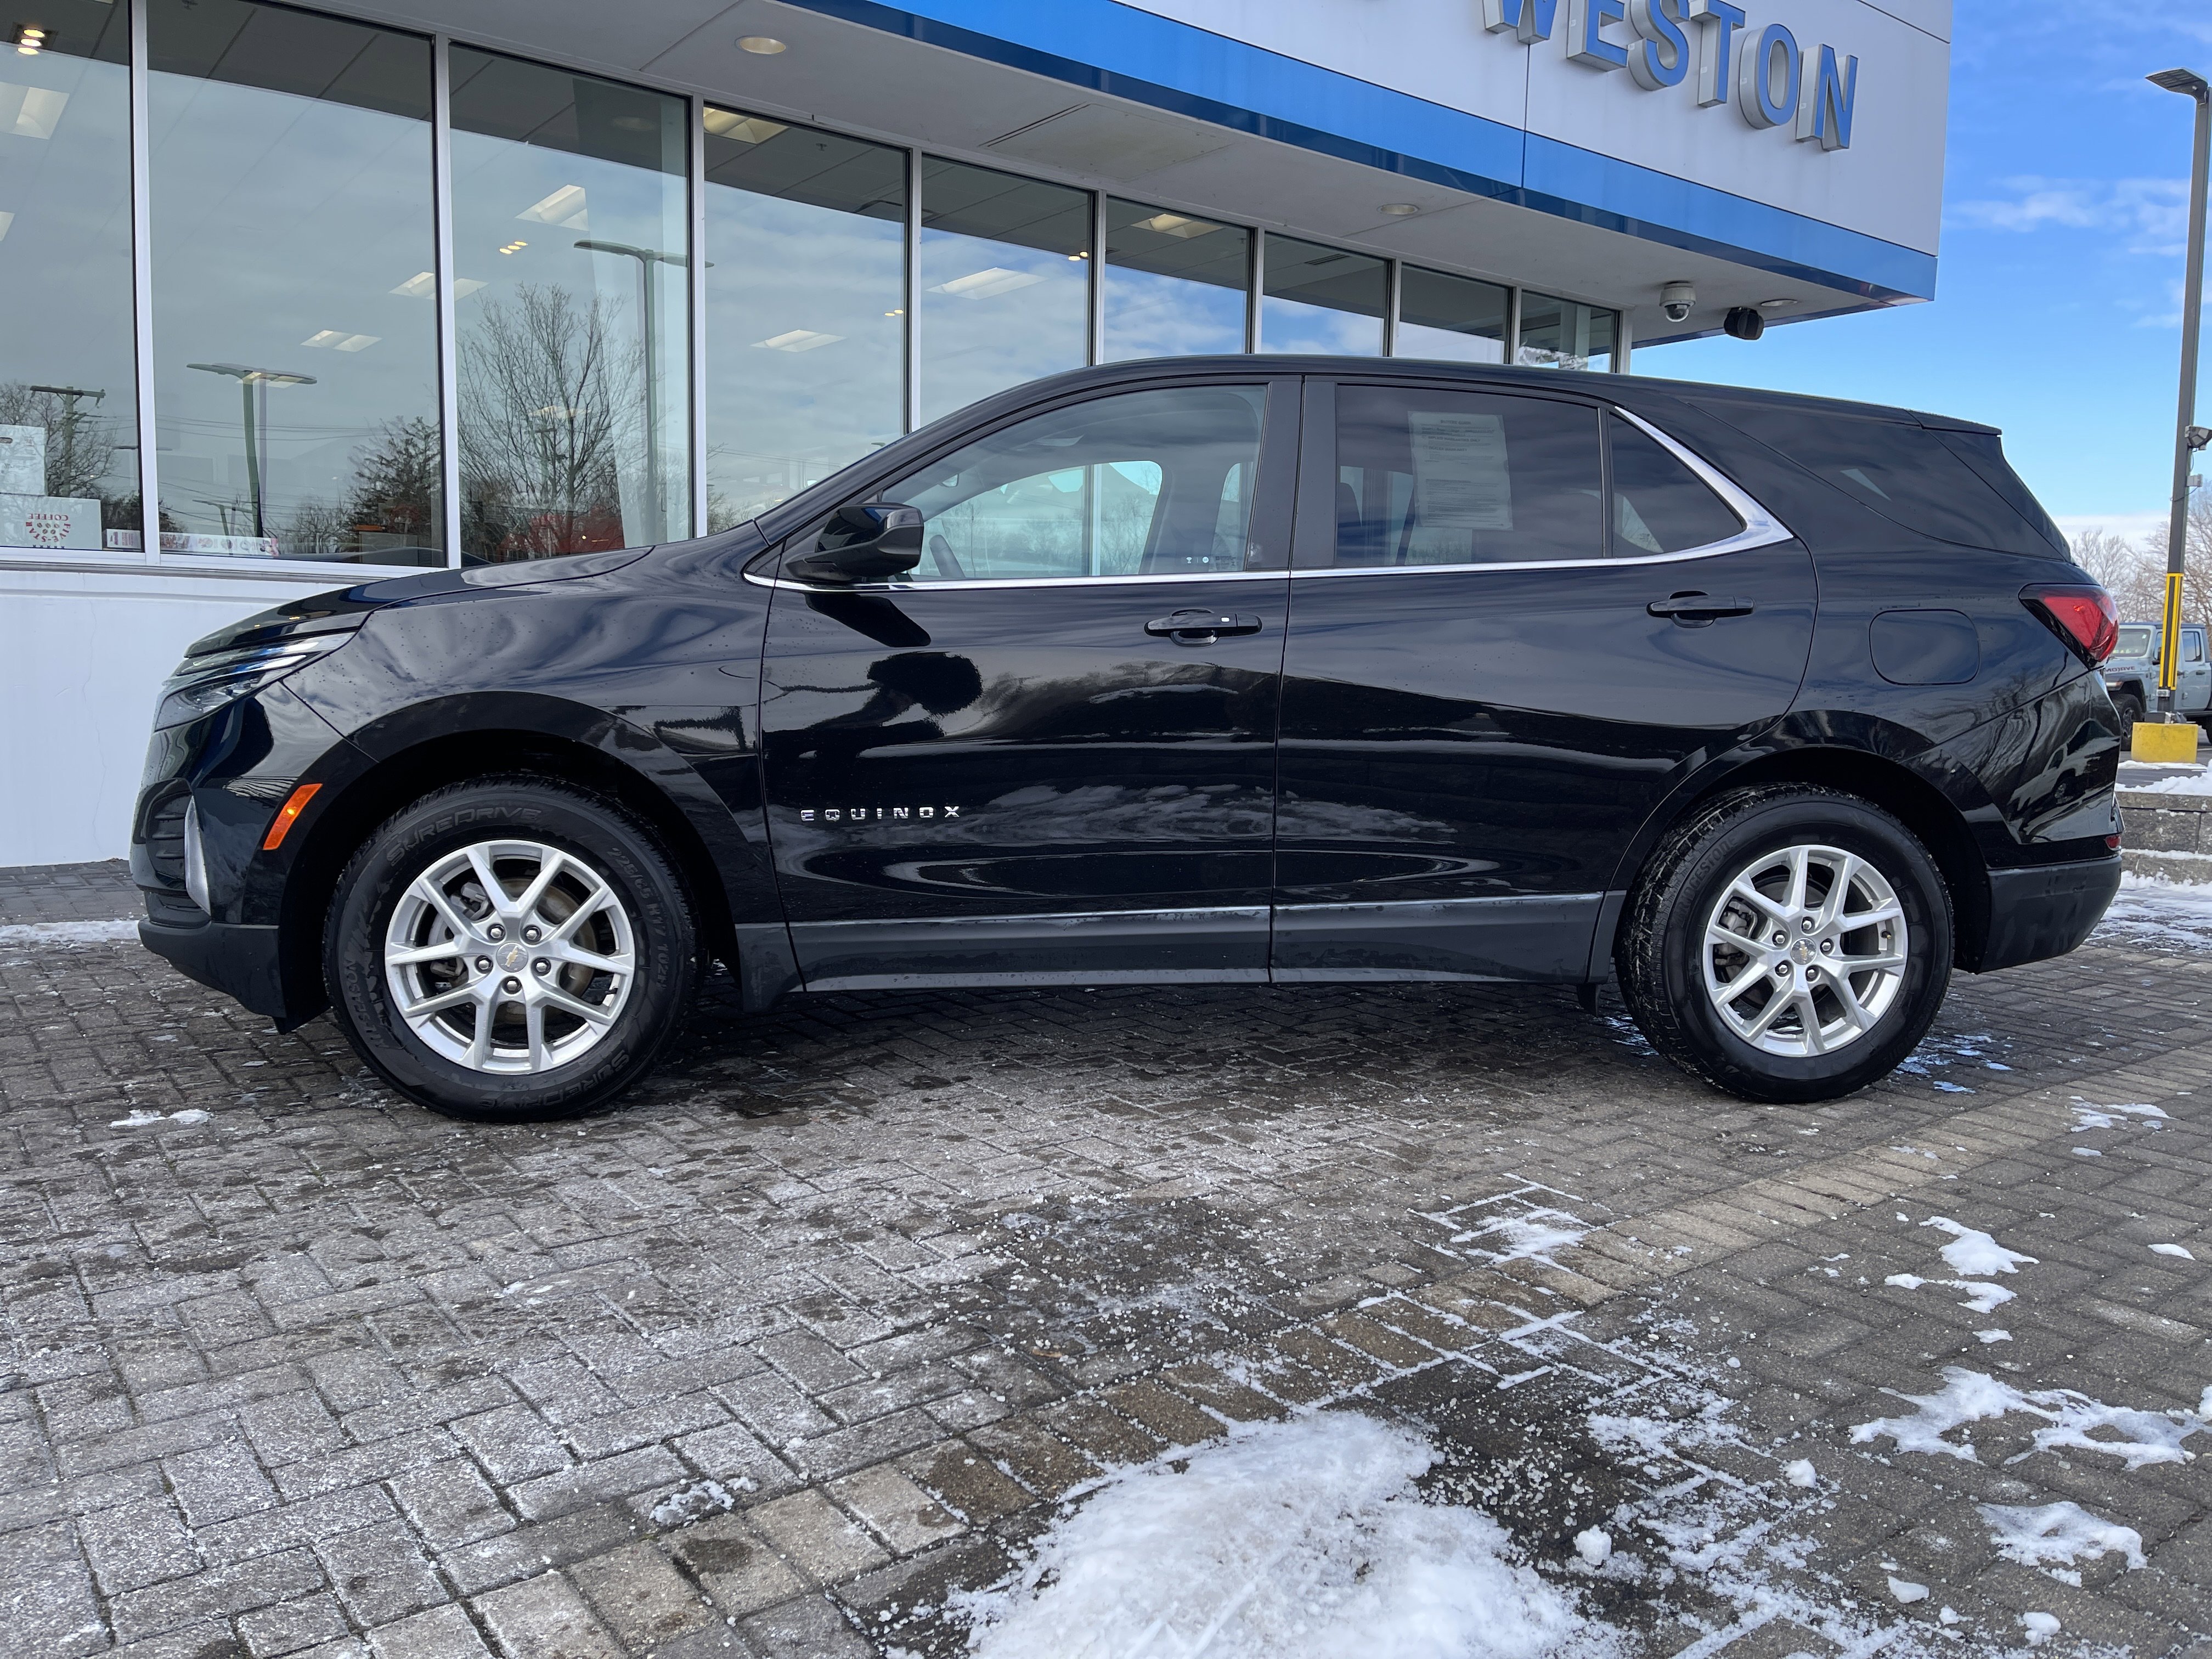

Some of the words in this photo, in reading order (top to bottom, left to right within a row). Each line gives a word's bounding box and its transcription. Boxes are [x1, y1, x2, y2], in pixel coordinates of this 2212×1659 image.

[27, 513, 69, 521] COFFEE
[800, 805, 960, 822] EQUINOX
[478, 1048, 629, 1108] SUREDRE
